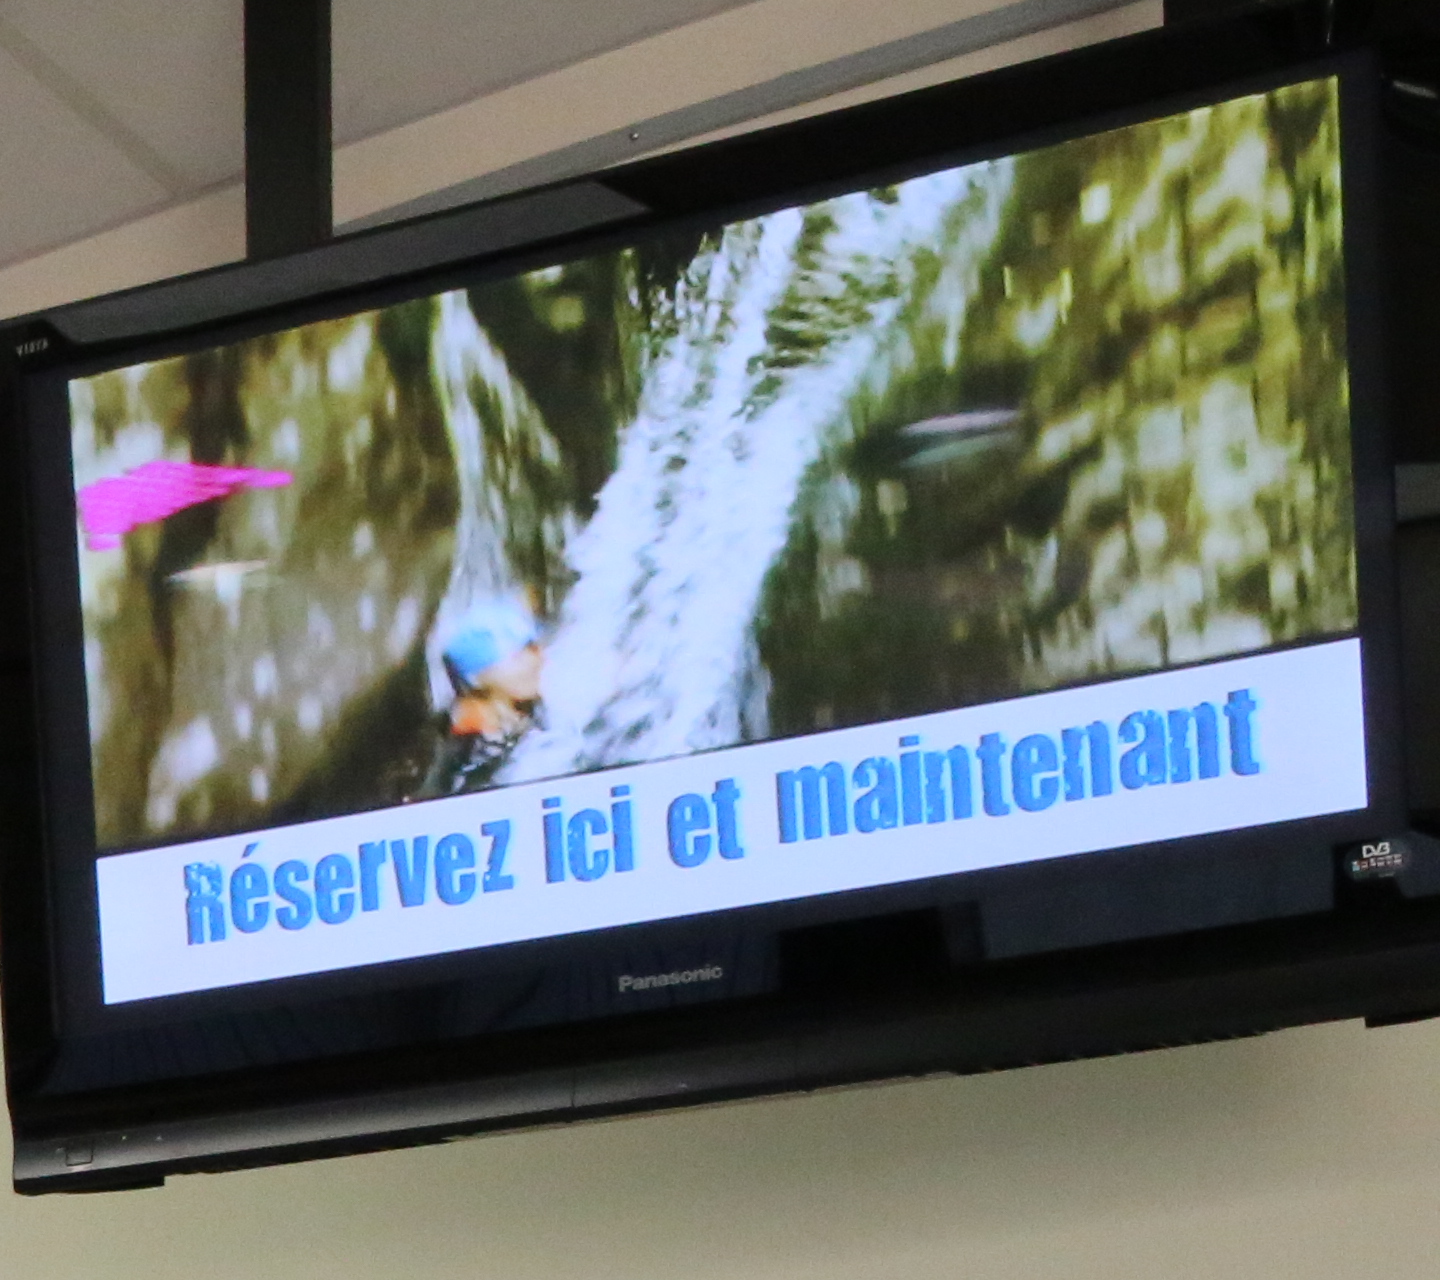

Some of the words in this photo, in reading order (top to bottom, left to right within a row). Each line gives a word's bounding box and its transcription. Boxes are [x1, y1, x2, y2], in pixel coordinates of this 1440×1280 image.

[184, 816, 514, 946] Réservez
[540, 784, 636, 885] ici
[667, 779, 744, 869] et
[774, 686, 1261, 846] maintenant
[618, 964, 723, 992] Panasonic
